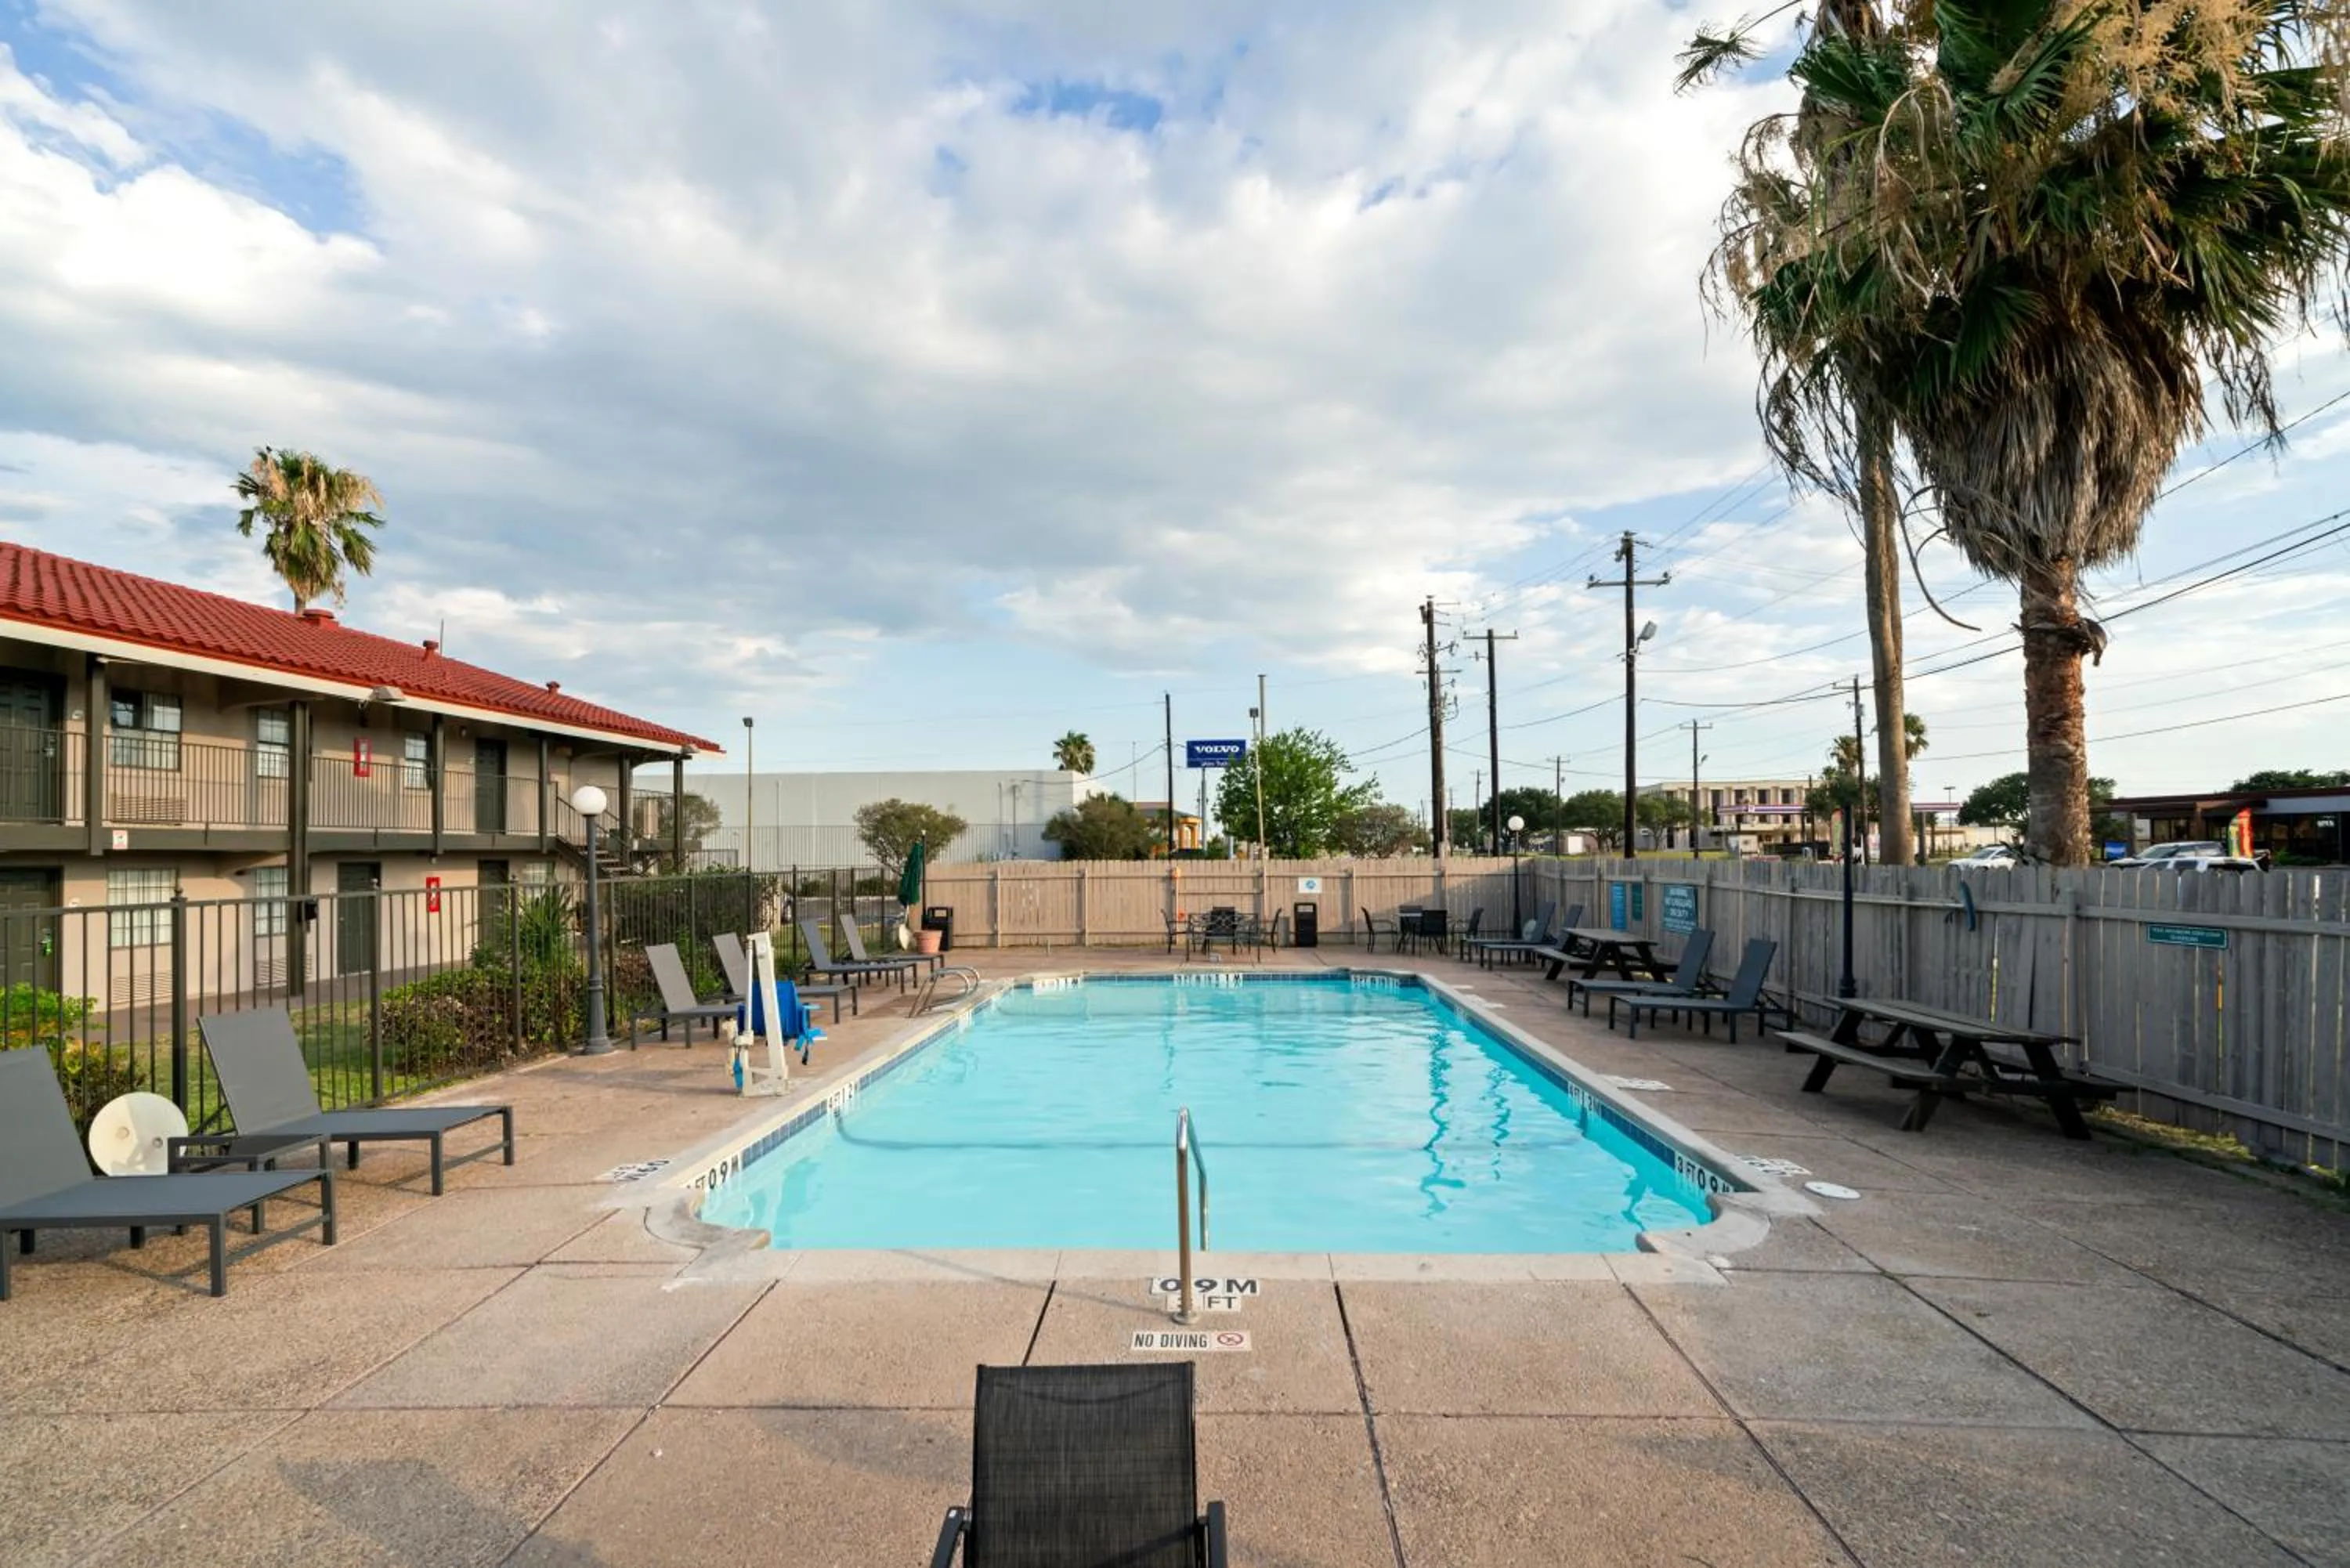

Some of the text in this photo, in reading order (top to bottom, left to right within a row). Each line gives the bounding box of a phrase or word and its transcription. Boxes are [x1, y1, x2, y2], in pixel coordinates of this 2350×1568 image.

[1195, 745, 1240, 753] VOLVO
[1133, 1334, 1208, 1348] NO DIVING
